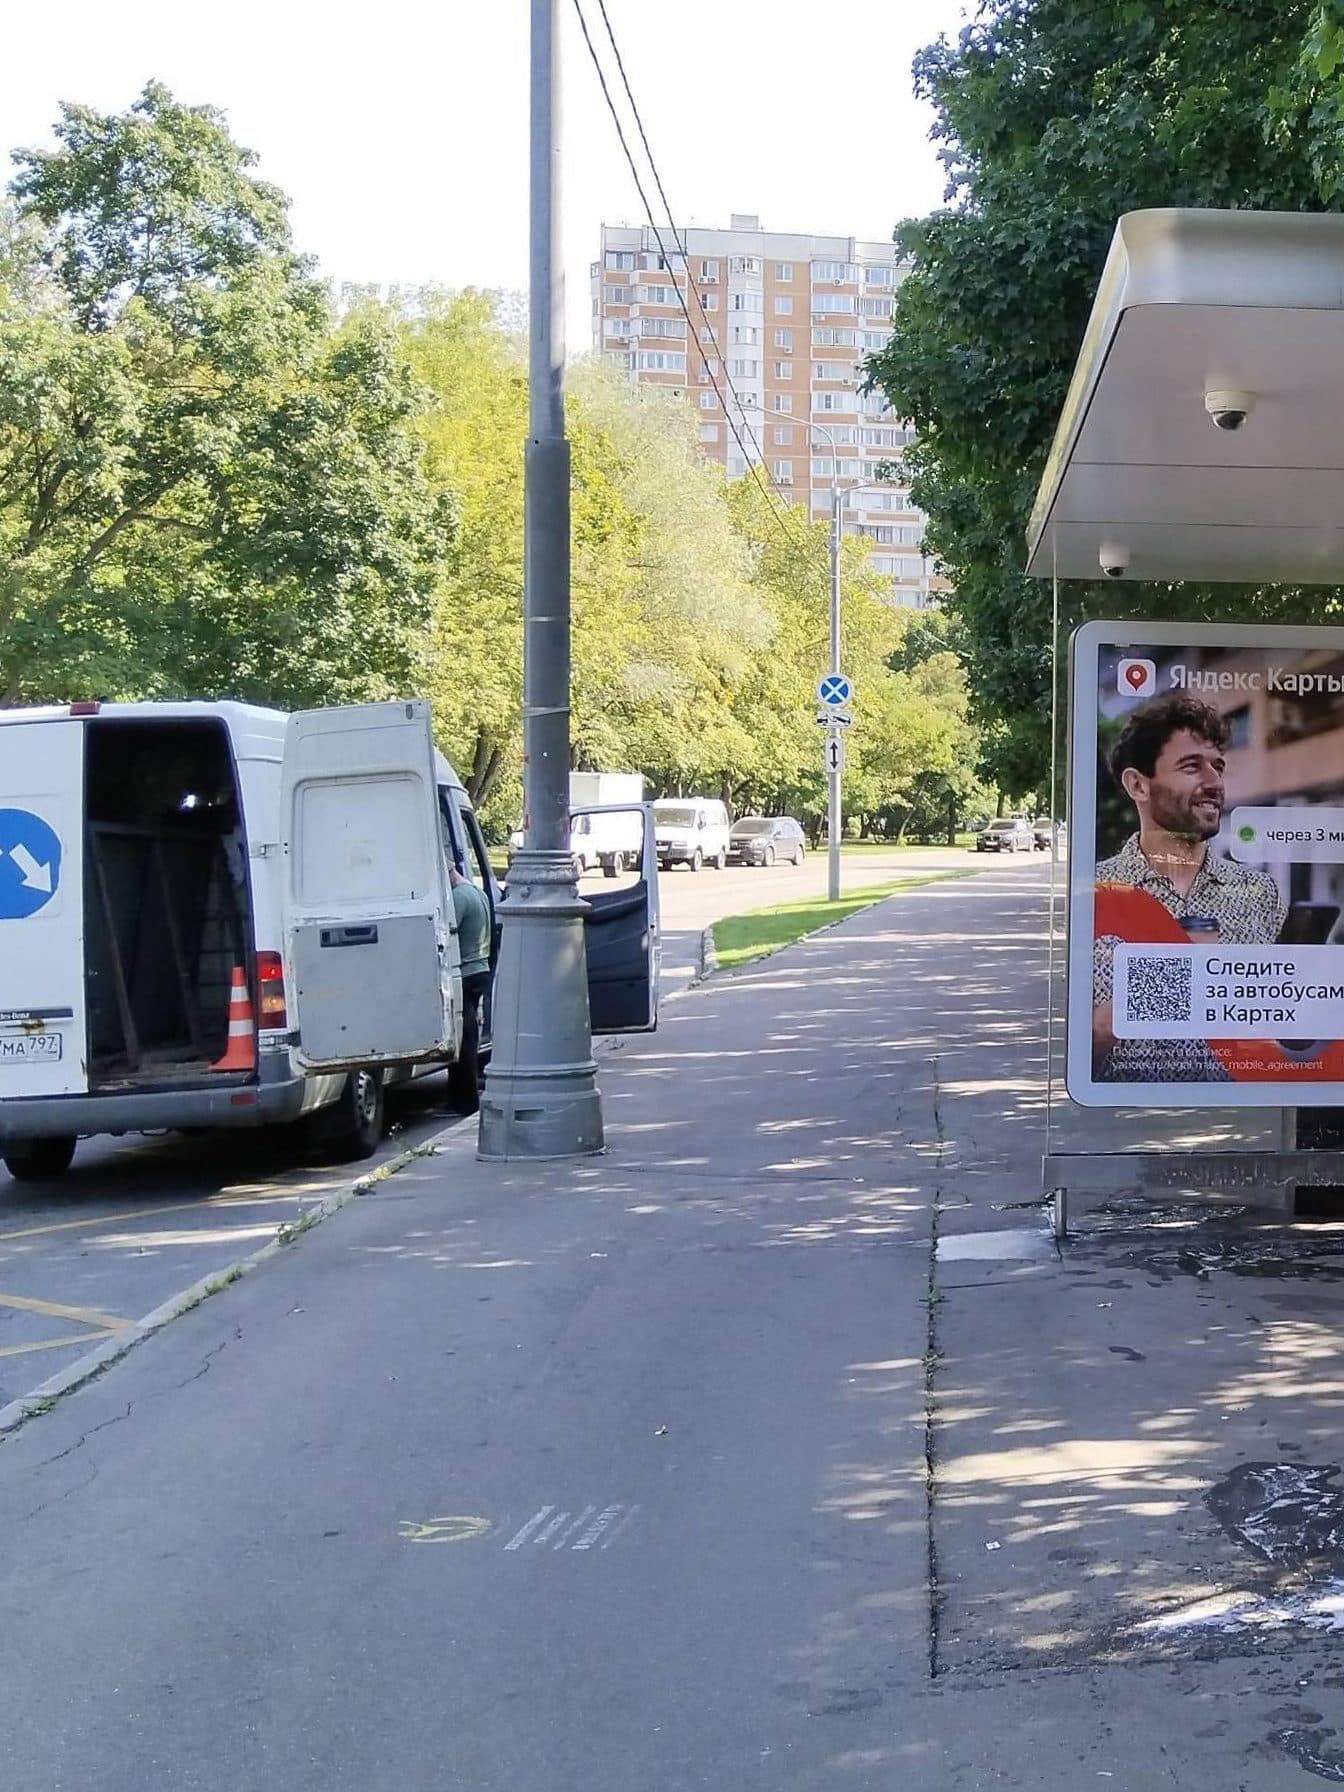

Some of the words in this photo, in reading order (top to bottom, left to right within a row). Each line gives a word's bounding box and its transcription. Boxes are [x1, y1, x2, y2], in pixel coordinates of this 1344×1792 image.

[1169, 665, 1261, 692] Яндекс
[1266, 831, 1311, 844] через
[1316, 829, 1325, 842] 3
[1206, 958, 1295, 978] Следите
[1206, 987, 1228, 999] за
[1206, 1009, 1217, 1022] в
[1223, 1005, 1296, 1025] Картах
[29, 1036, 55, 1050] 797
